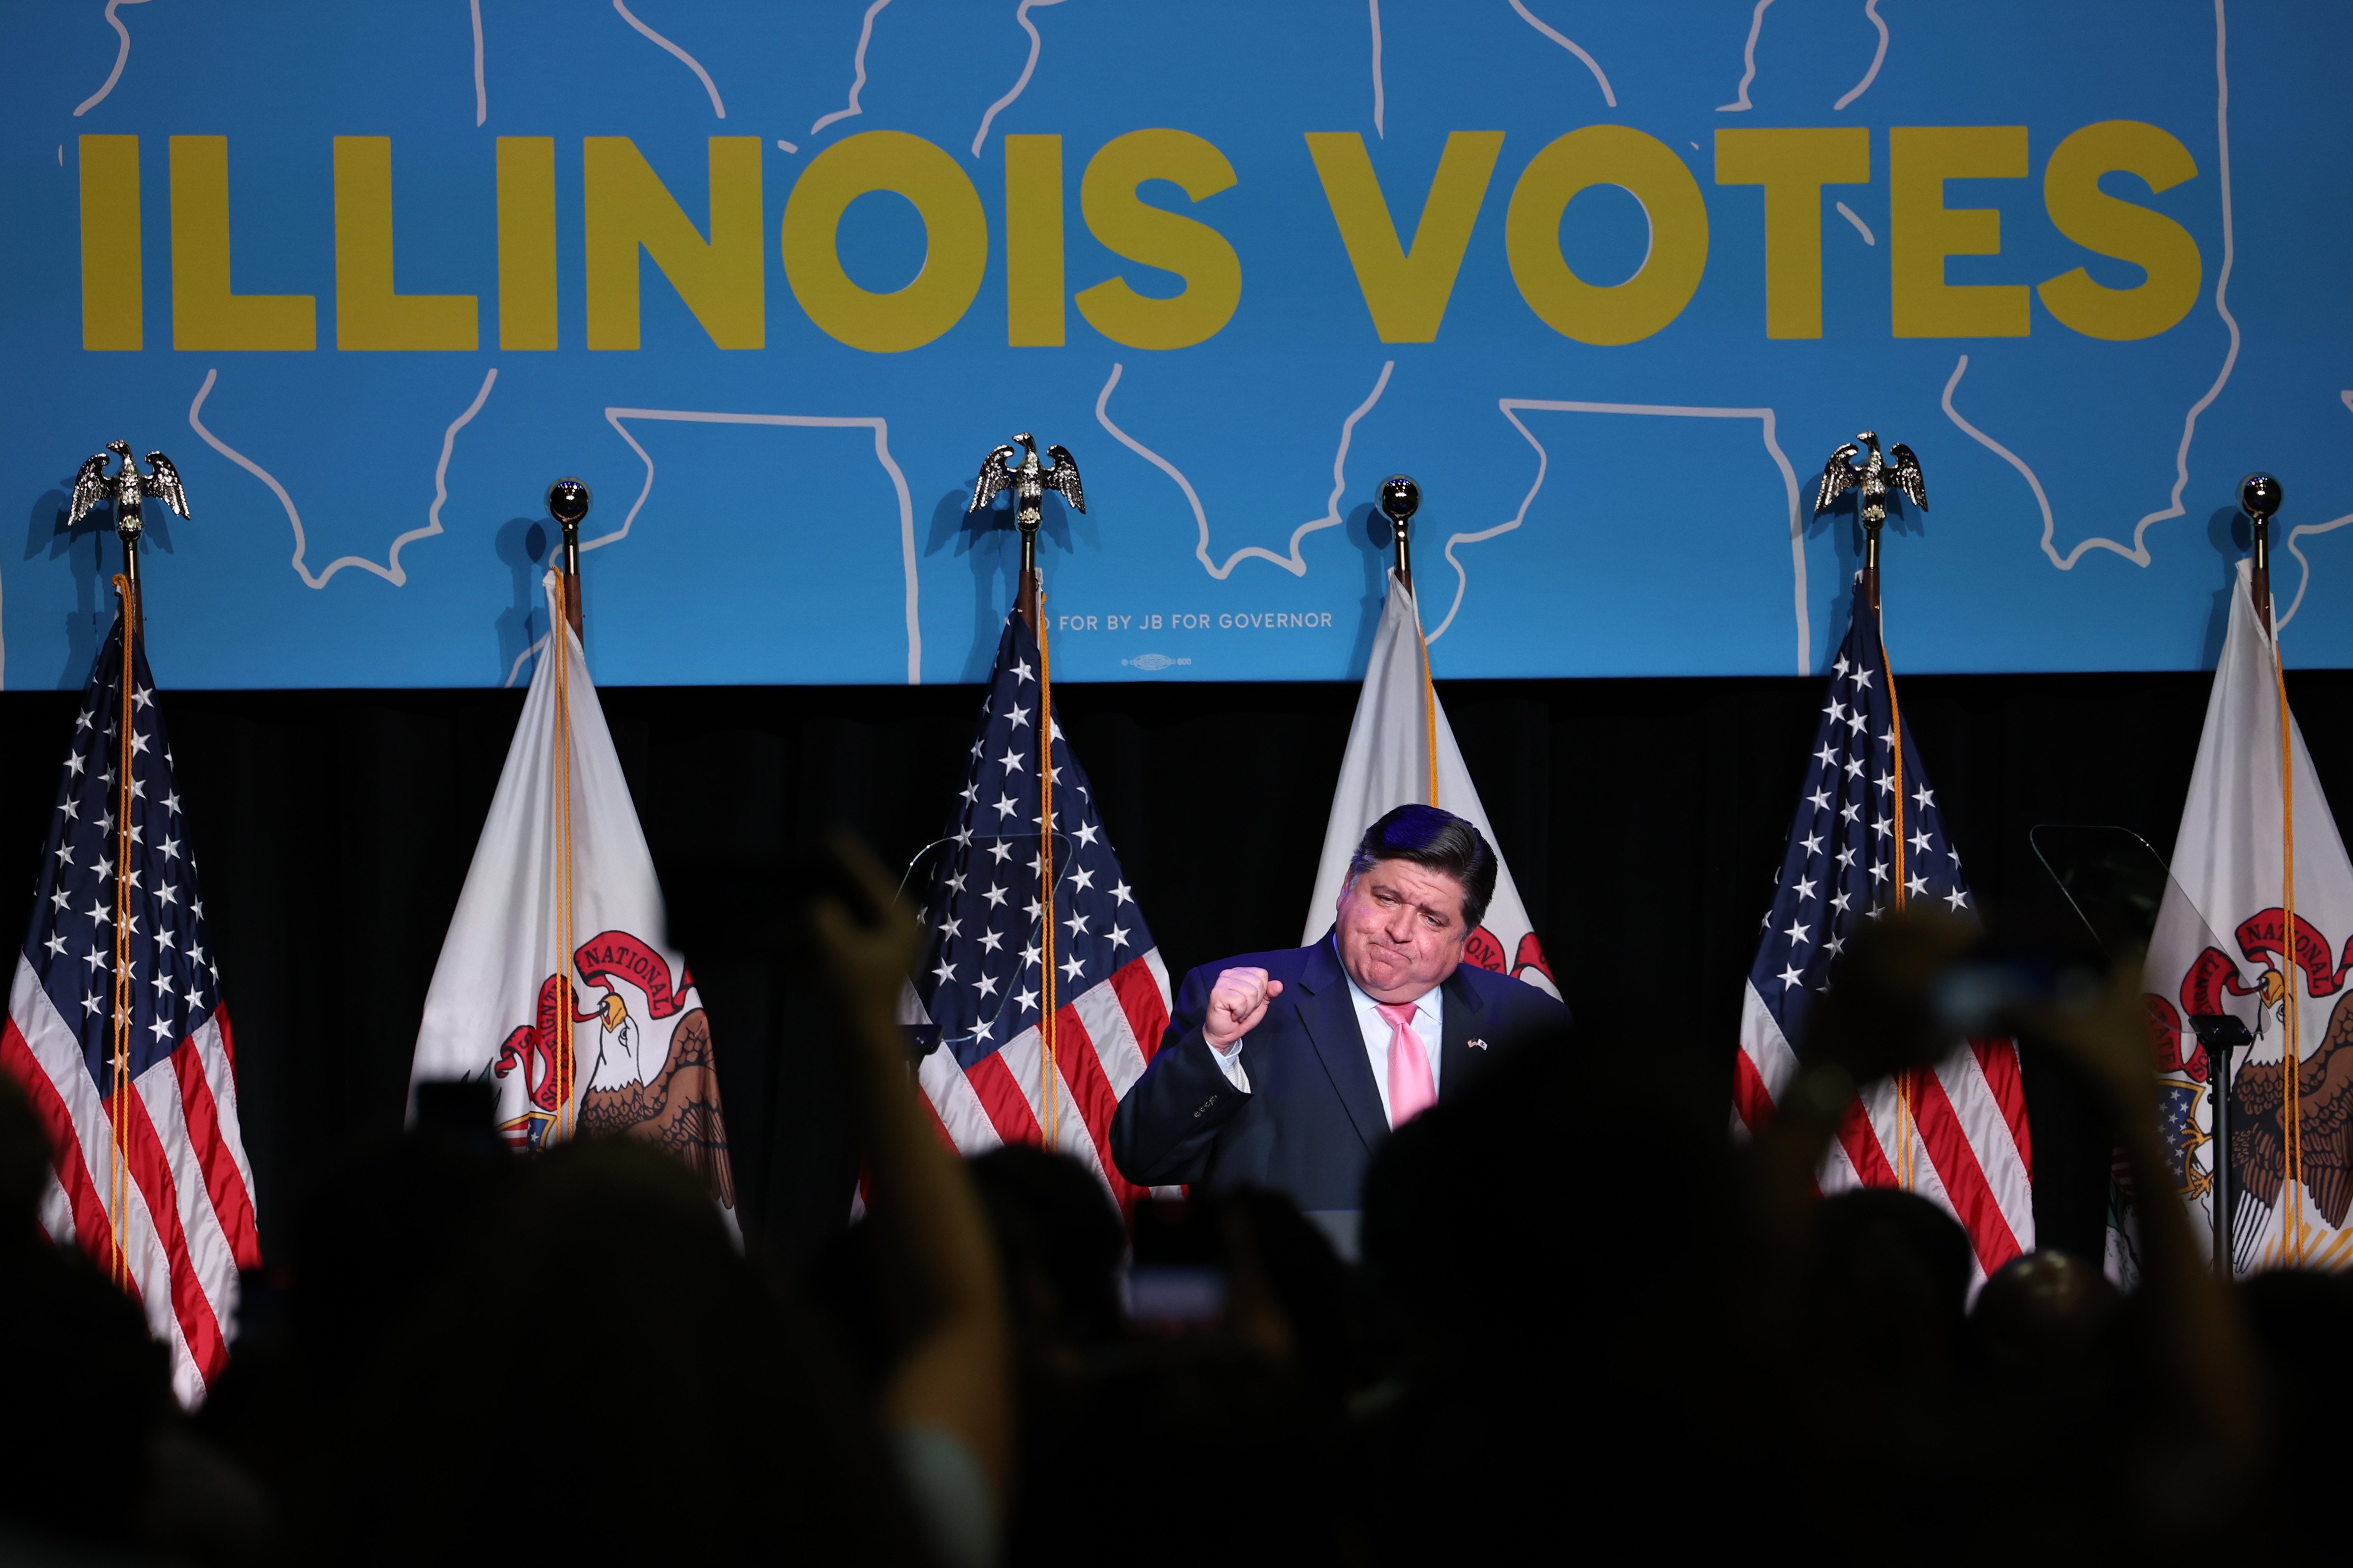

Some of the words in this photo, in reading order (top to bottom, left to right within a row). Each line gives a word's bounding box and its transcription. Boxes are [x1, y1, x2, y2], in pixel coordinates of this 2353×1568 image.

[79, 128, 1242, 353] ILLINOIS
[1304, 120, 2202, 346] VOTES
[1059, 615, 1097, 631] FOR
[1107, 615, 1131, 630] BY
[1139, 614, 1163, 630] JB
[1172, 614, 1210, 629] FOR
[1219, 612, 1332, 629] GOVERNOR
[584, 946, 670, 1011] NATIONAL
